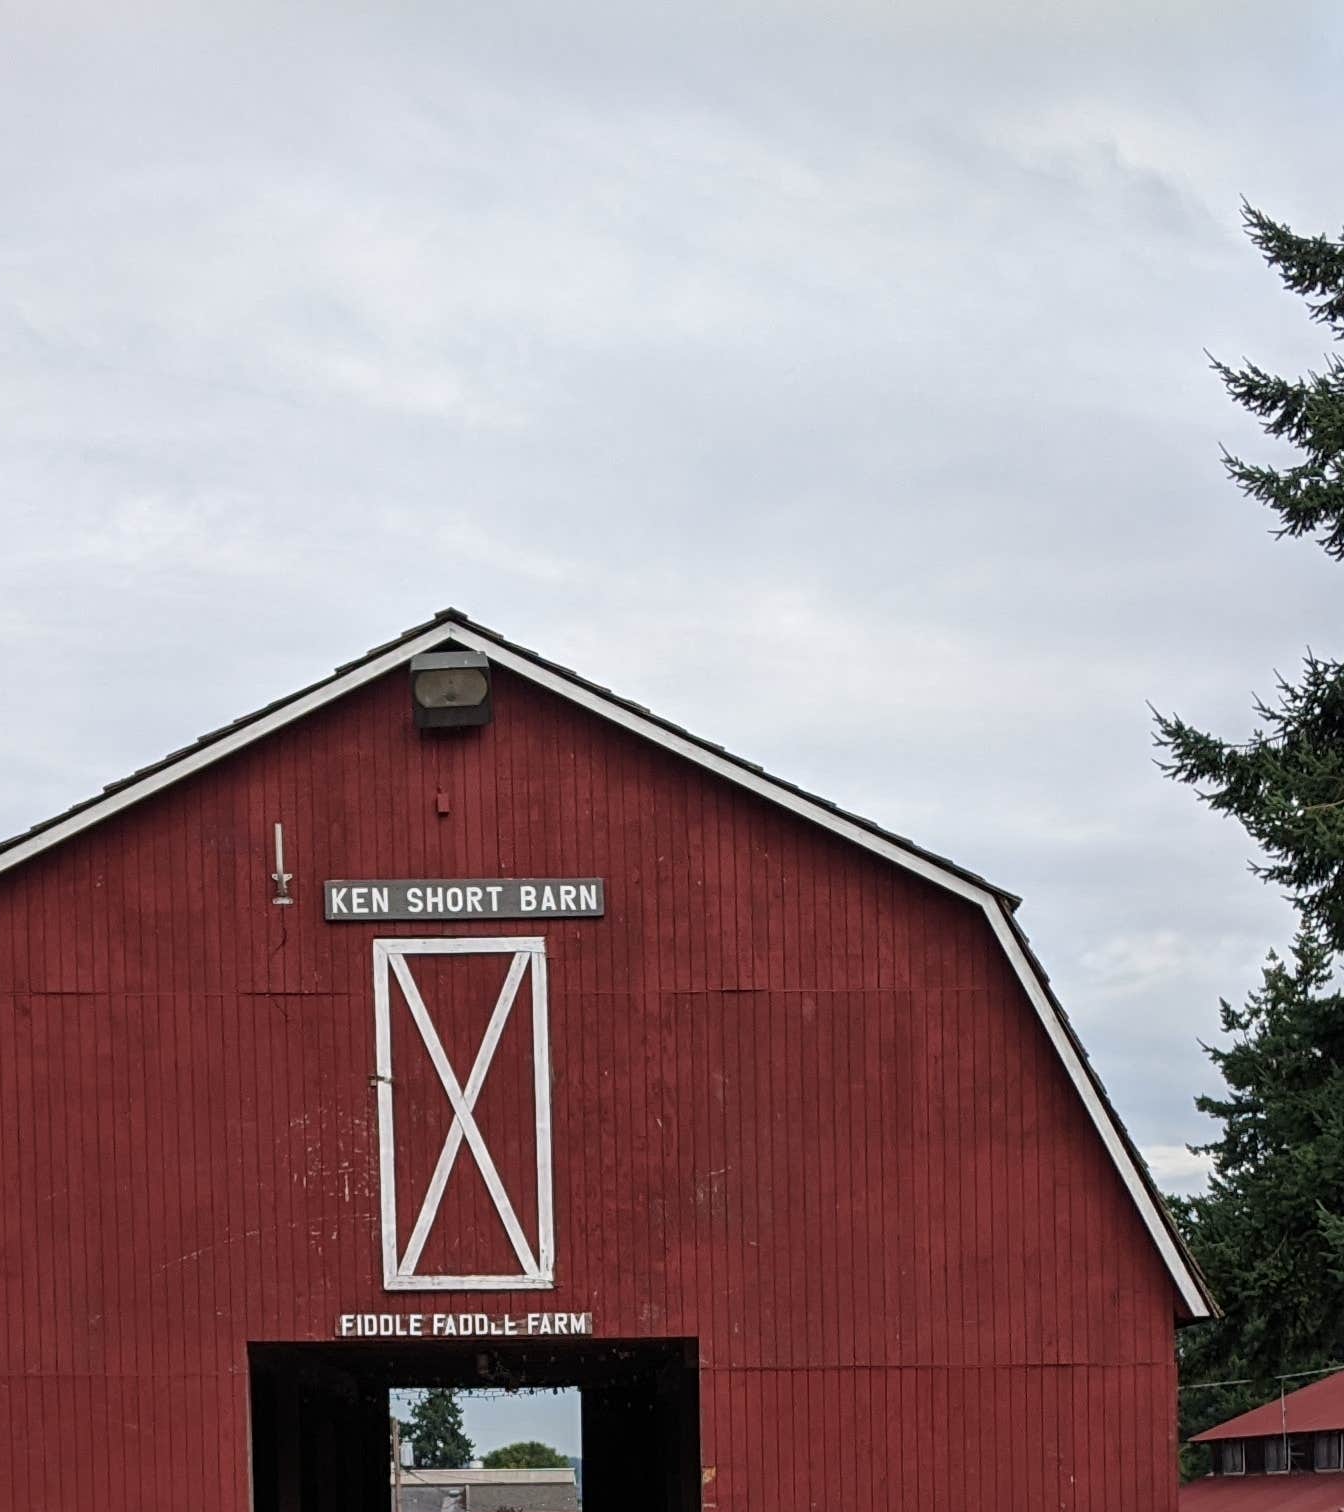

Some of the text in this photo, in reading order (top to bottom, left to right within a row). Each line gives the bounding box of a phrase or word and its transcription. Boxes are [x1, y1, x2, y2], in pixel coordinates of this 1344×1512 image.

[331, 884, 597, 914] KEN SHORT BARN
[341, 1314, 423, 1337] FIDDLE
[527, 1312, 587, 1335] FARM
